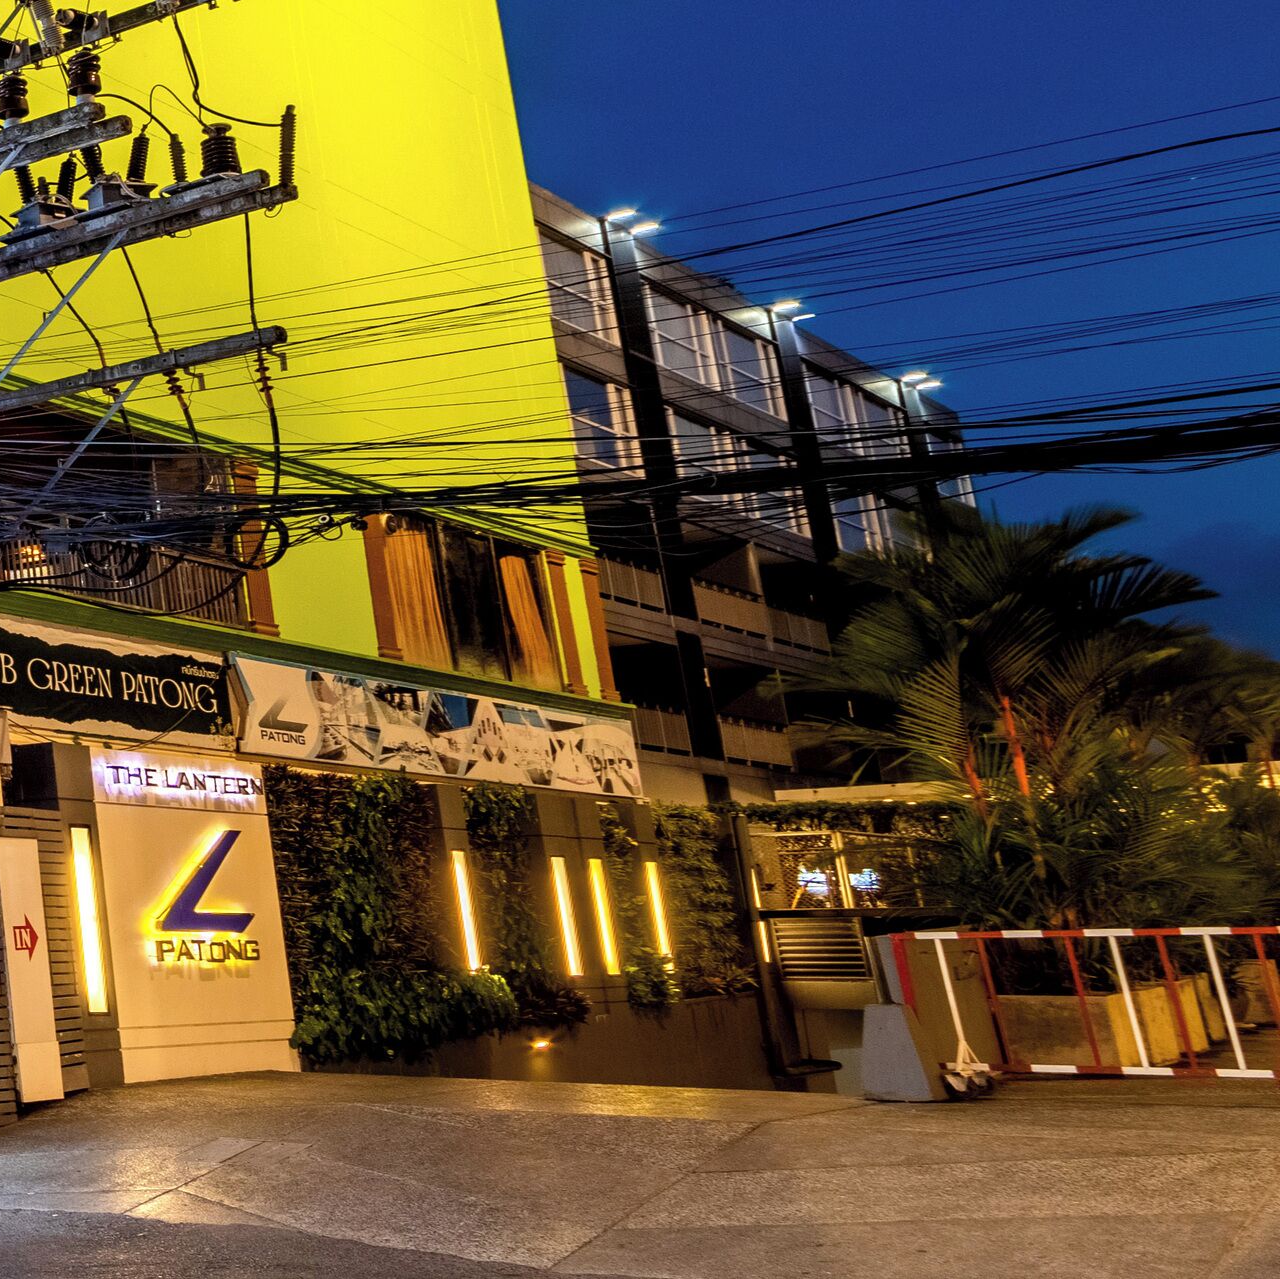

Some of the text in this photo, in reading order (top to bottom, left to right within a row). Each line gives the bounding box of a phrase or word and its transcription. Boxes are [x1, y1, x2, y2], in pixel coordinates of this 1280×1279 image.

[27, 657, 114, 700] GREEN
[122, 671, 218, 715] PATONG
[260, 729, 307, 746] PATONG
[105, 765, 265, 796] THE LANTERN
[16, 928, 32, 949] IN
[155, 939, 261, 962] PATONG
